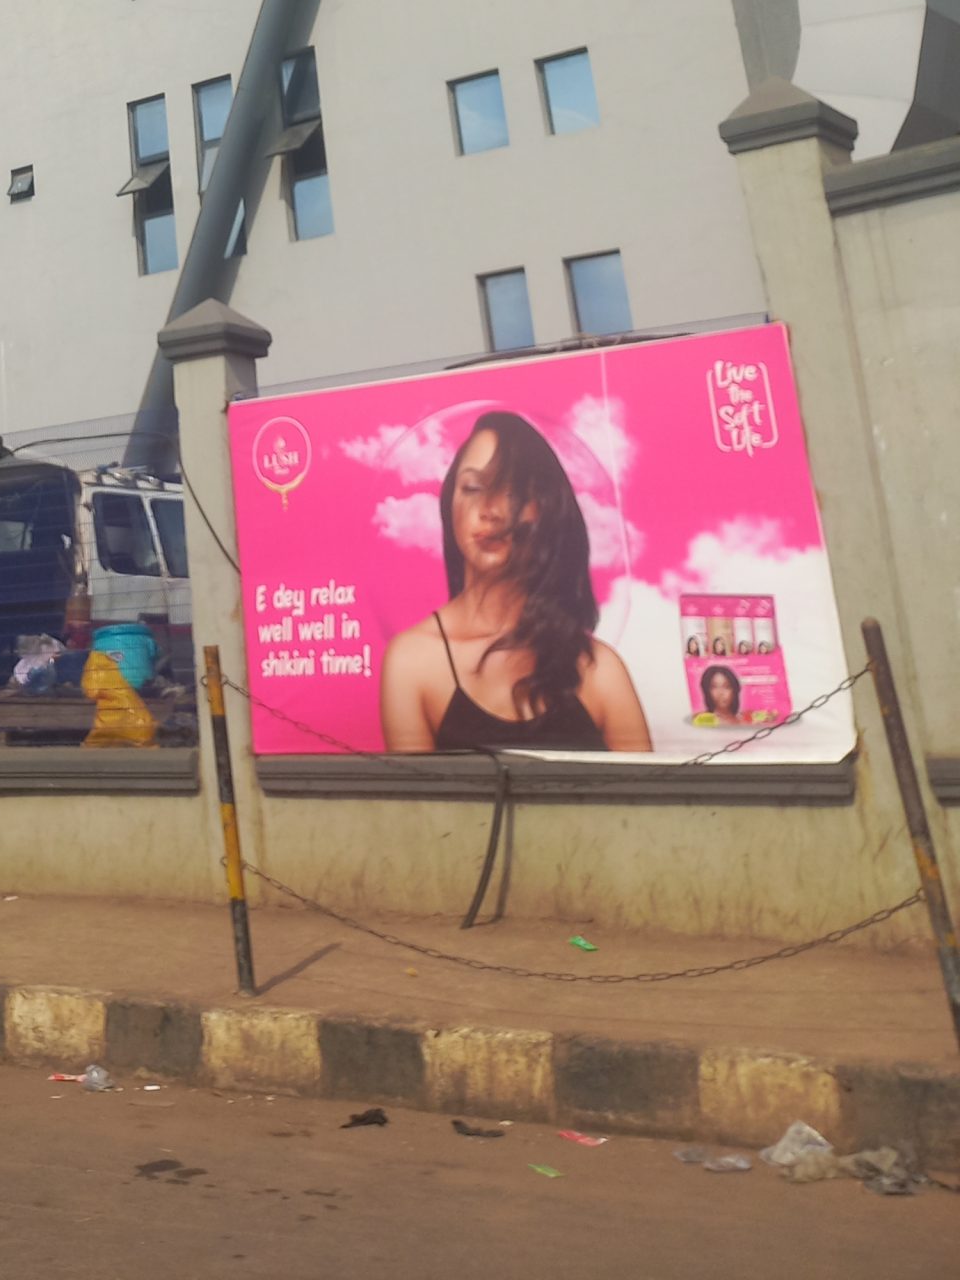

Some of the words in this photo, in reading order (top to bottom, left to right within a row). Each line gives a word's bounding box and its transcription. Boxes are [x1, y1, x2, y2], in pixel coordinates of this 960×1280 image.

[715, 360, 758, 388] Live
[256, 585, 267, 612] E
[272, 582, 305, 616] dey
[310, 578, 356, 607] relax
[258, 616, 293, 643] well
[298, 613, 335, 641] well
[341, 612, 360, 639] in
[261, 649, 315, 677] shikini
[321, 643, 371, 678] time!
